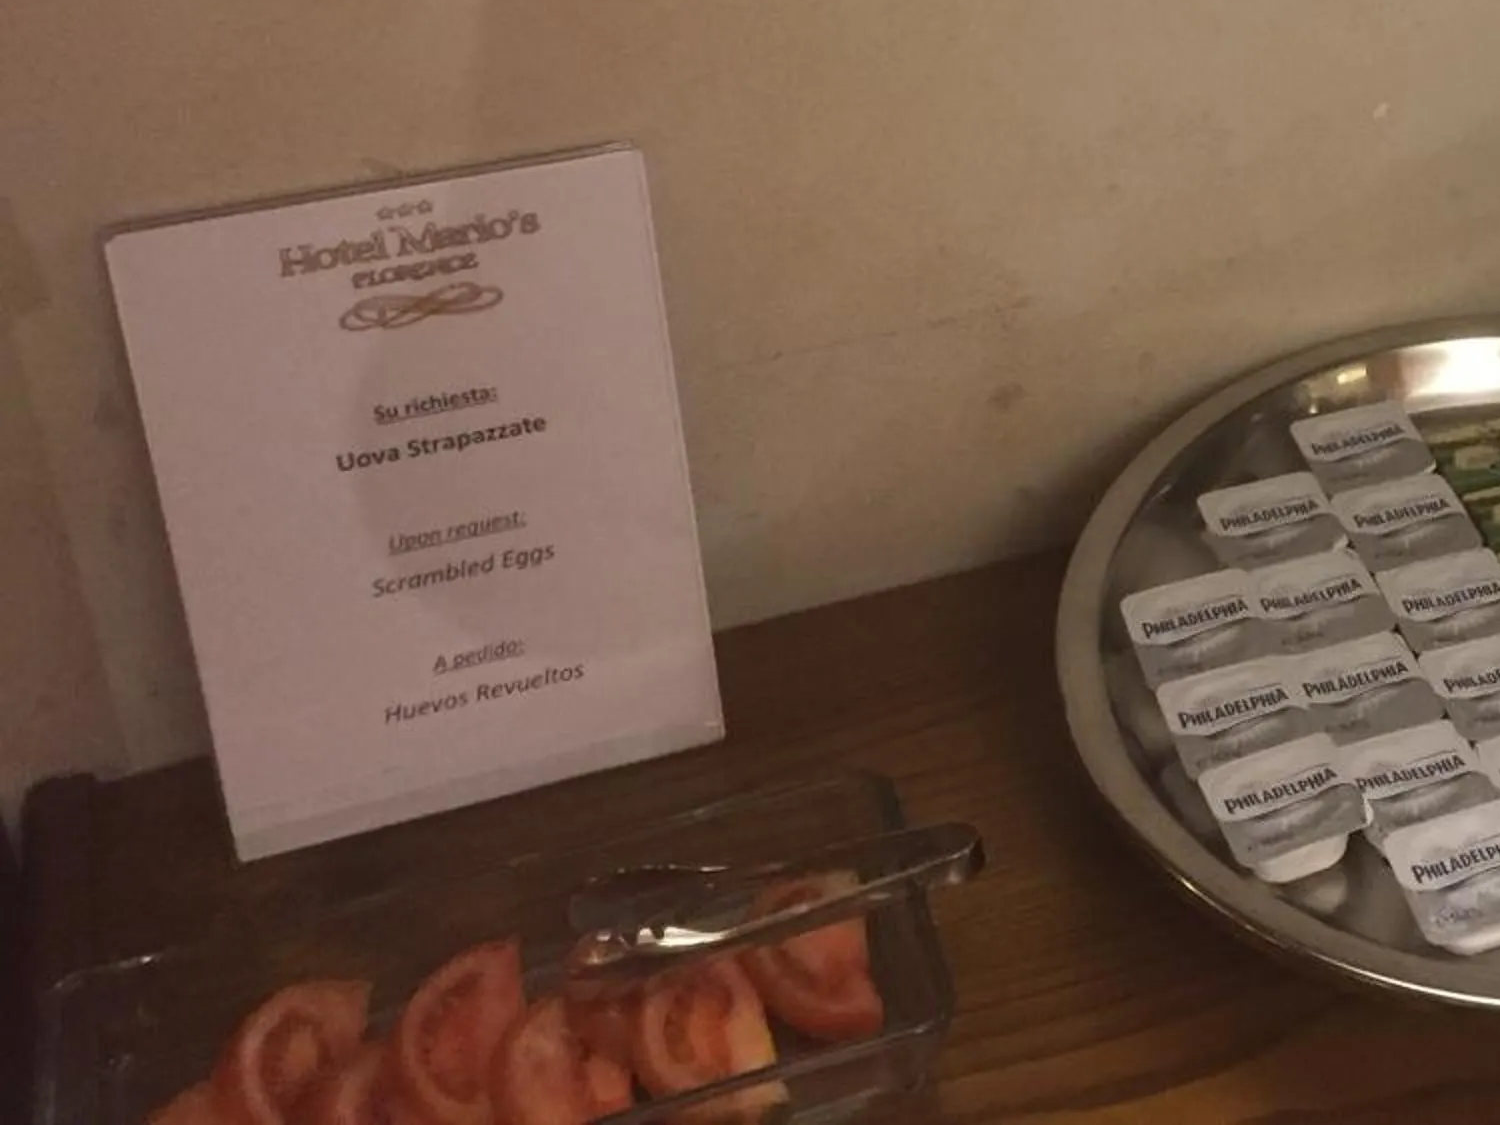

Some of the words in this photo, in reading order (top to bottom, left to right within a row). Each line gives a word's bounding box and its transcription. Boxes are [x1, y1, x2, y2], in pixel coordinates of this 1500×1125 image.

[279, 228, 390, 278] Hotel
[373, 403, 400, 425] Su
[405, 386, 498, 417] richiesta:
[336, 445, 400, 472] Uova
[408, 417, 547, 457] Strapazzate
[1312, 423, 1404, 455] PHILADELPHIA
[1220, 498, 1320, 532] PHILADELPHIA
[1354, 497, 1451, 529] PHILADELPHIA
[389, 529, 443, 557] Upon
[447, 510, 527, 545] request:
[372, 559, 494, 596] Scrambled
[503, 545, 555, 571] Eggs
[1261, 577, 1362, 613] PHILADELPHIA
[1142, 598, 1249, 639] PHILADELPHIA
[432, 654, 449, 674] A
[453, 637, 526, 670] pedido:
[384, 693, 469, 725] Huevos
[476, 663, 585, 702] Revueltos
[1303, 661, 1409, 698] PHILADELPHIA
[1178, 688, 1290, 729] PHILADELPHIA
[1224, 766, 1339, 814] PHILADELPHIA
[1356, 754, 1466, 792] PHILADELPHIA
